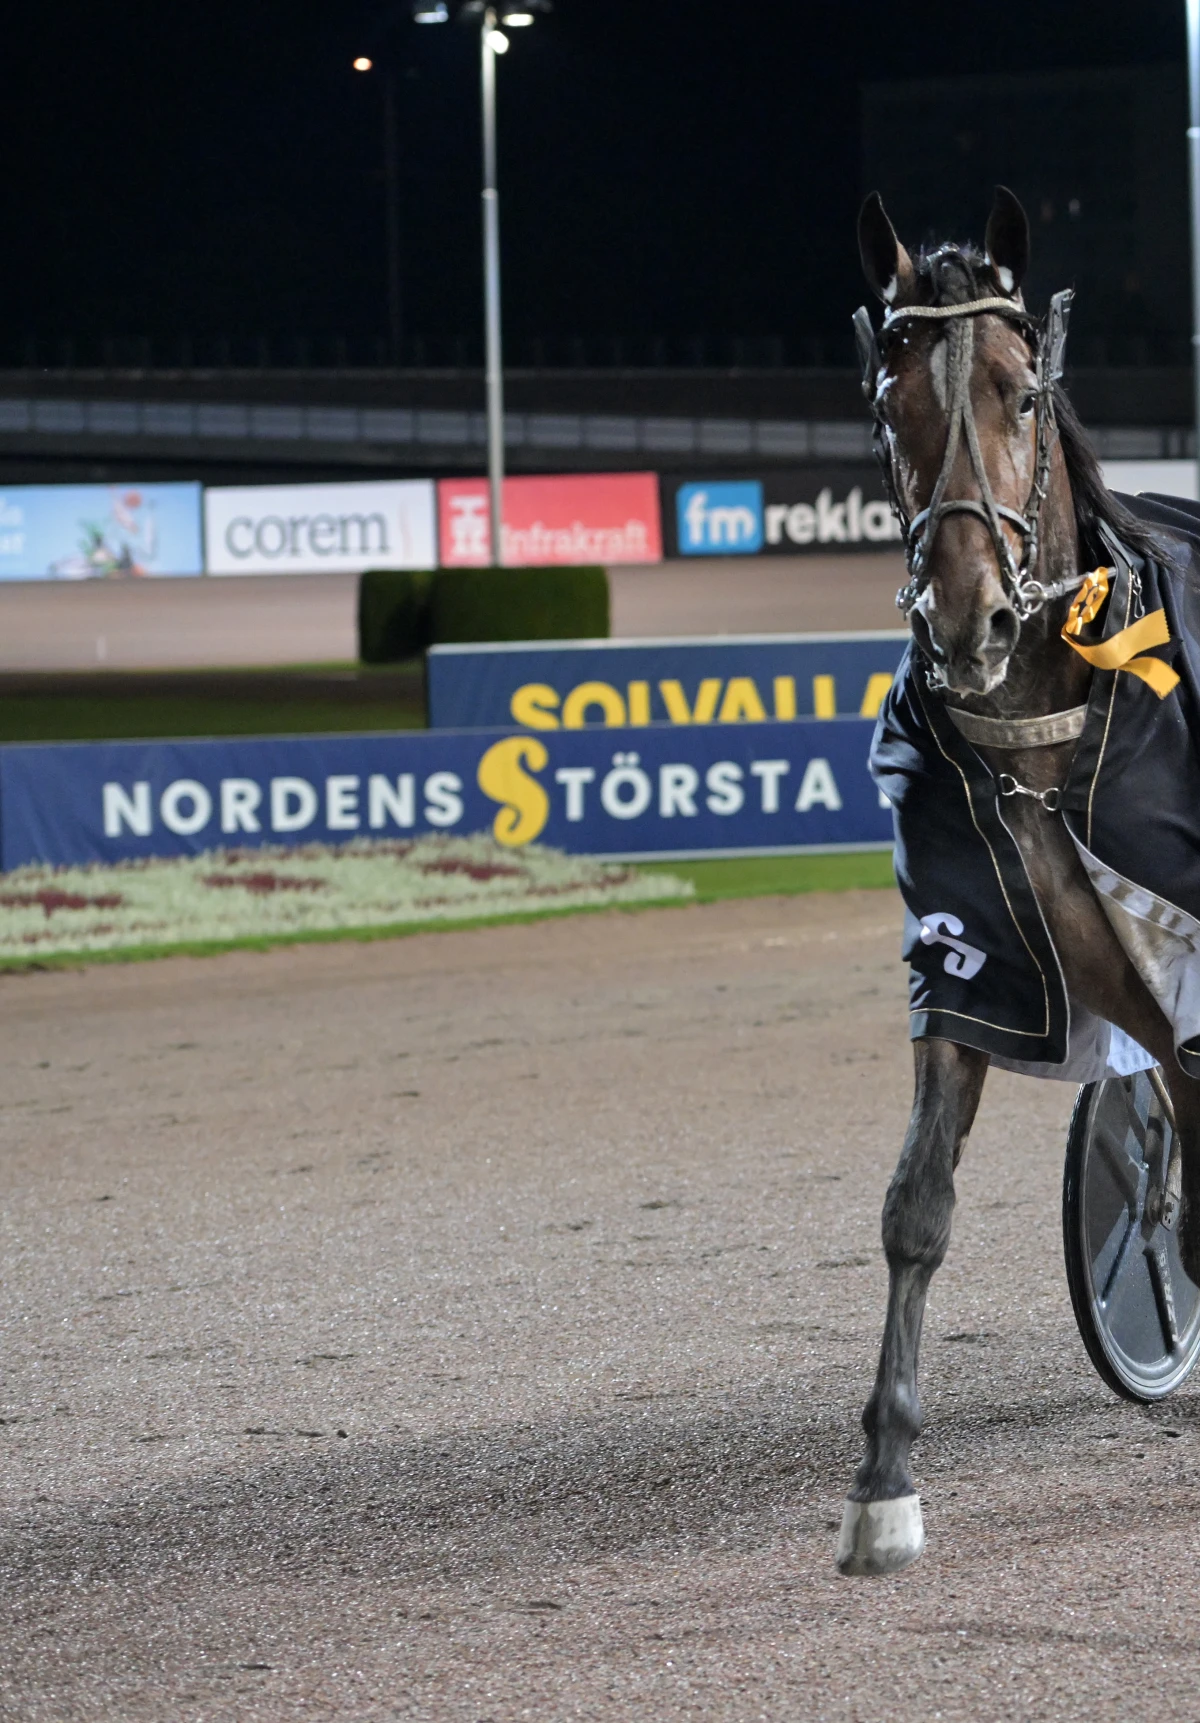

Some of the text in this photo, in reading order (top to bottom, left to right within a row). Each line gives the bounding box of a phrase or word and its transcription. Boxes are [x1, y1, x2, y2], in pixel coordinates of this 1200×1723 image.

[224, 511, 391, 559] corem
[685, 487, 902, 546] fm rekla
[103, 771, 465, 837] NORDENS
